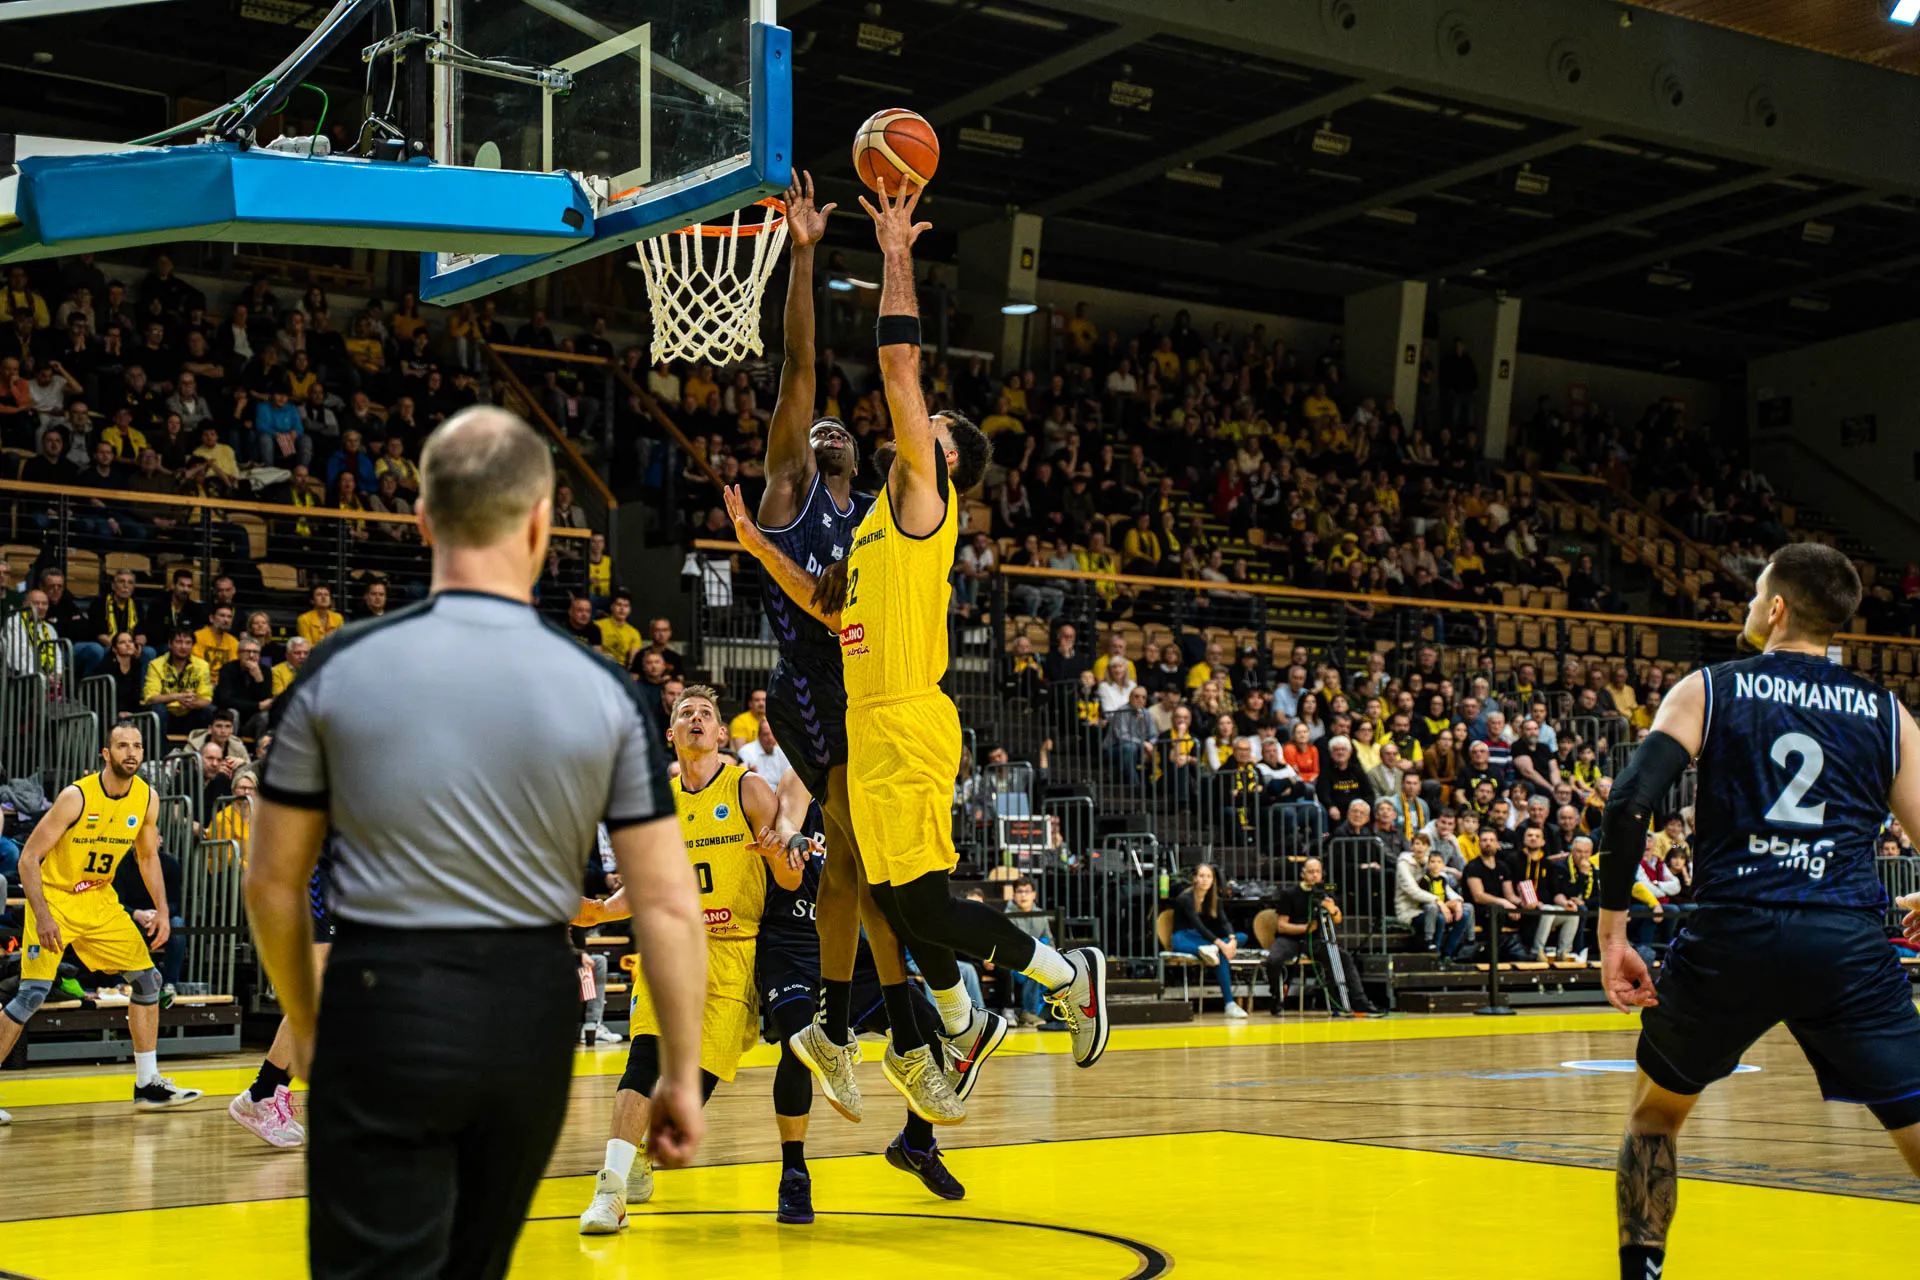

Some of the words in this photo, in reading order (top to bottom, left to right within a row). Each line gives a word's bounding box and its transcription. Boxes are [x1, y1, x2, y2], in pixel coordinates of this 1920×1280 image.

[1735, 672, 1878, 719] NORMANTAS
[1764, 732, 1826, 825] 2
[695, 833, 744, 848] SZOMBATHELY
[83, 851, 114, 874] 13
